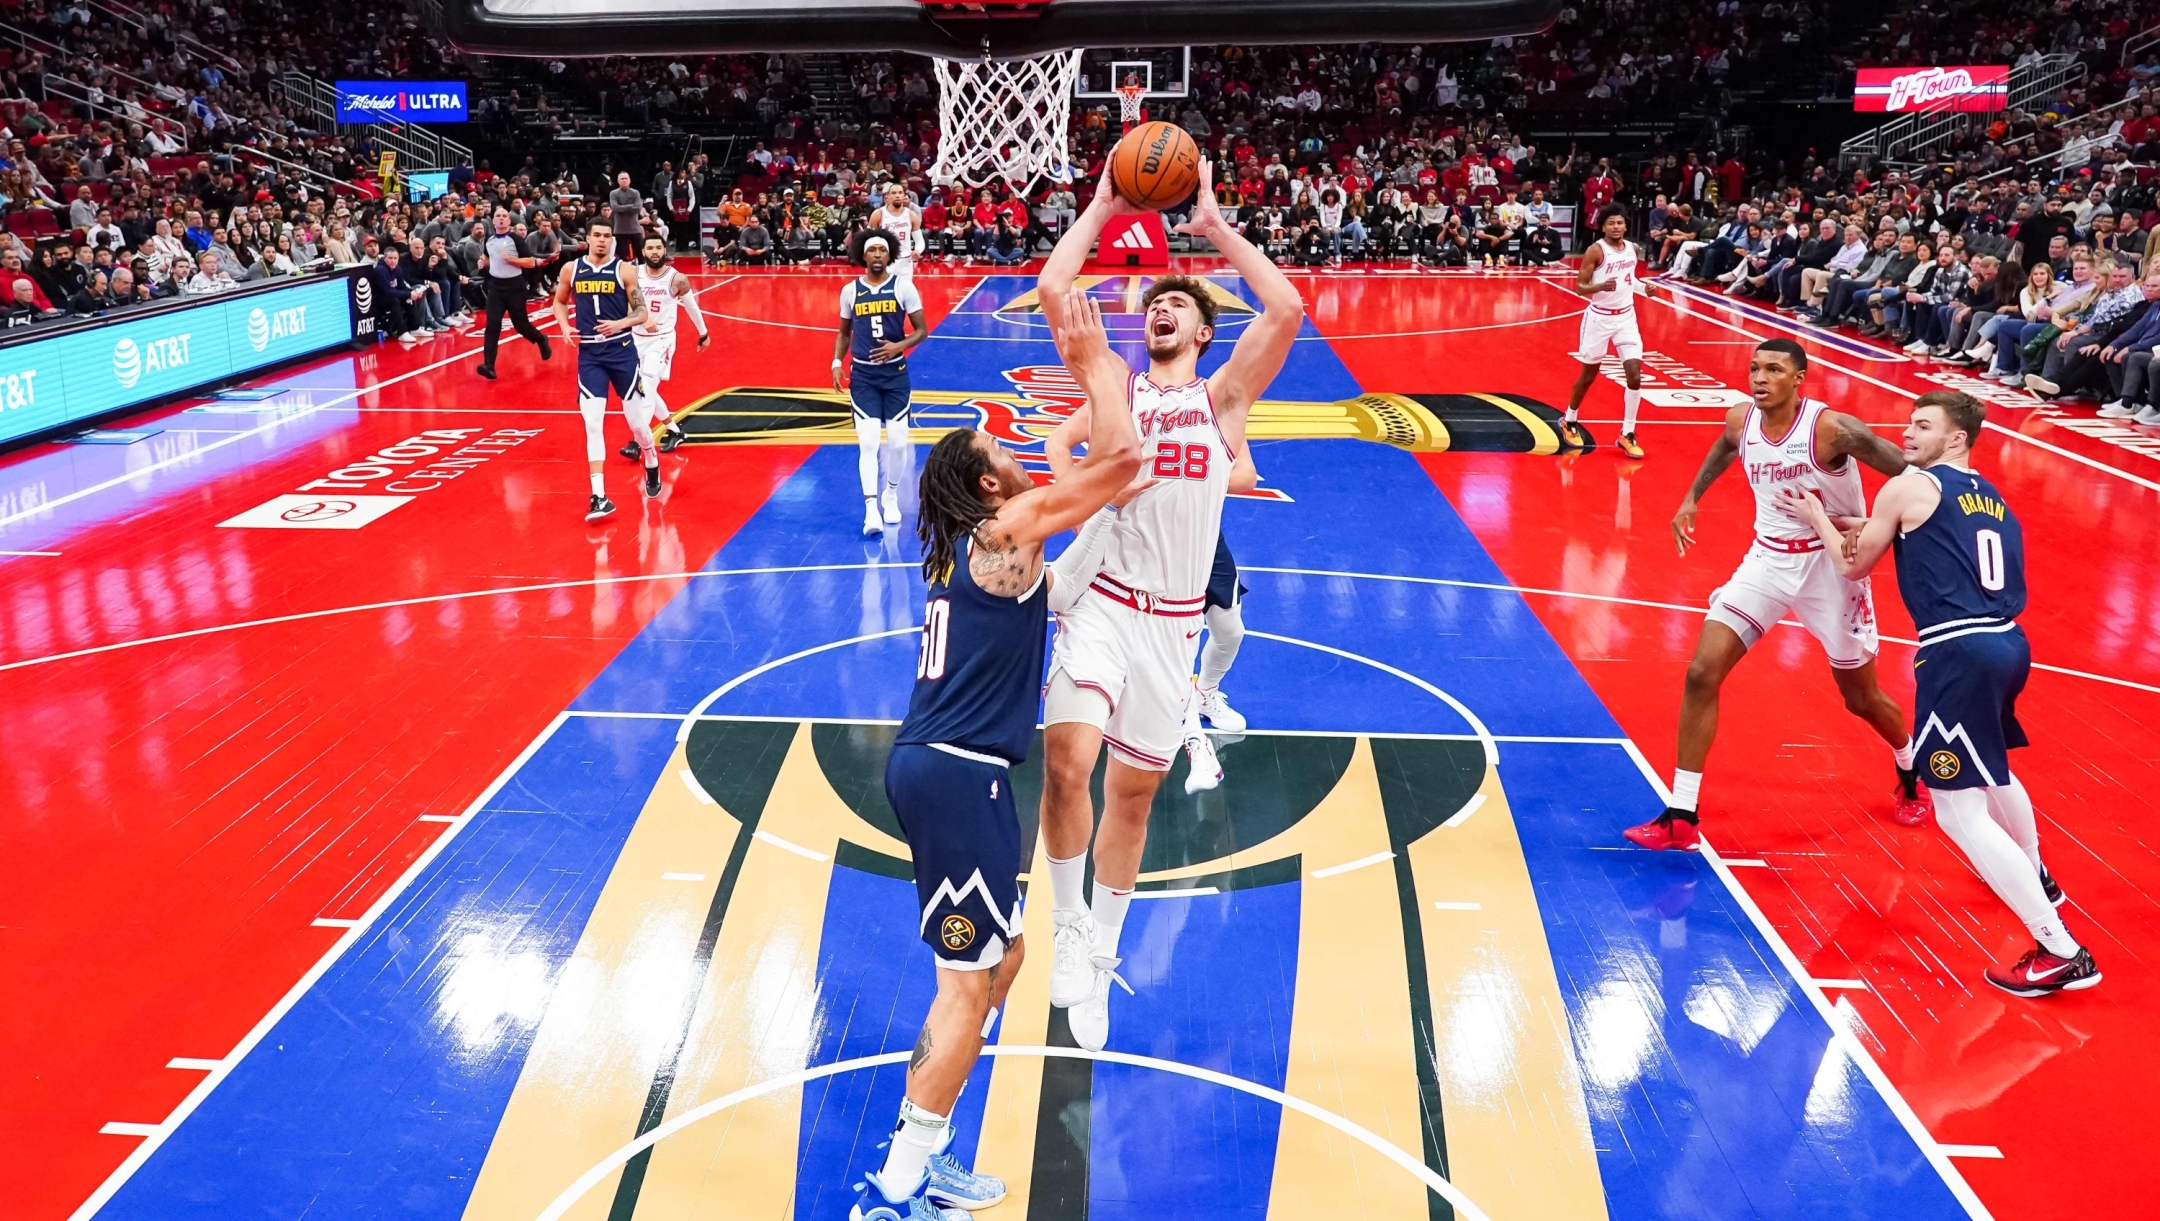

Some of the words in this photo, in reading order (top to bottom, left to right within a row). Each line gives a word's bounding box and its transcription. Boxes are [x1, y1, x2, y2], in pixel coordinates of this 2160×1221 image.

[344, 94, 397, 110] Michelob
[409, 94, 462, 109] ULTRA
[1889, 69, 1970, 109] H-Town
[1141, 125, 1174, 175] Wilson
[1605, 260, 1636, 274] H-Town
[1624, 272, 1632, 286] 4
[575, 280, 615, 294] DENVER
[592, 294, 601, 316] 1
[650, 300, 661, 313] 5
[854, 300, 897, 316] DENVER
[272, 305, 308, 340] AT&T
[356, 316, 375, 337] AT&T
[870, 315, 884, 338] 5
[145, 333, 192, 374] AT&T
[1138, 406, 1210, 437] H-Town
[295, 427, 484, 492] TOYOTA
[384, 427, 546, 493] CENTER
[1151, 440, 1211, 481] 28
[1750, 461, 1813, 485] H-Town
[1957, 492, 2005, 522] BRAUN
[1976, 528, 2005, 591] 0
